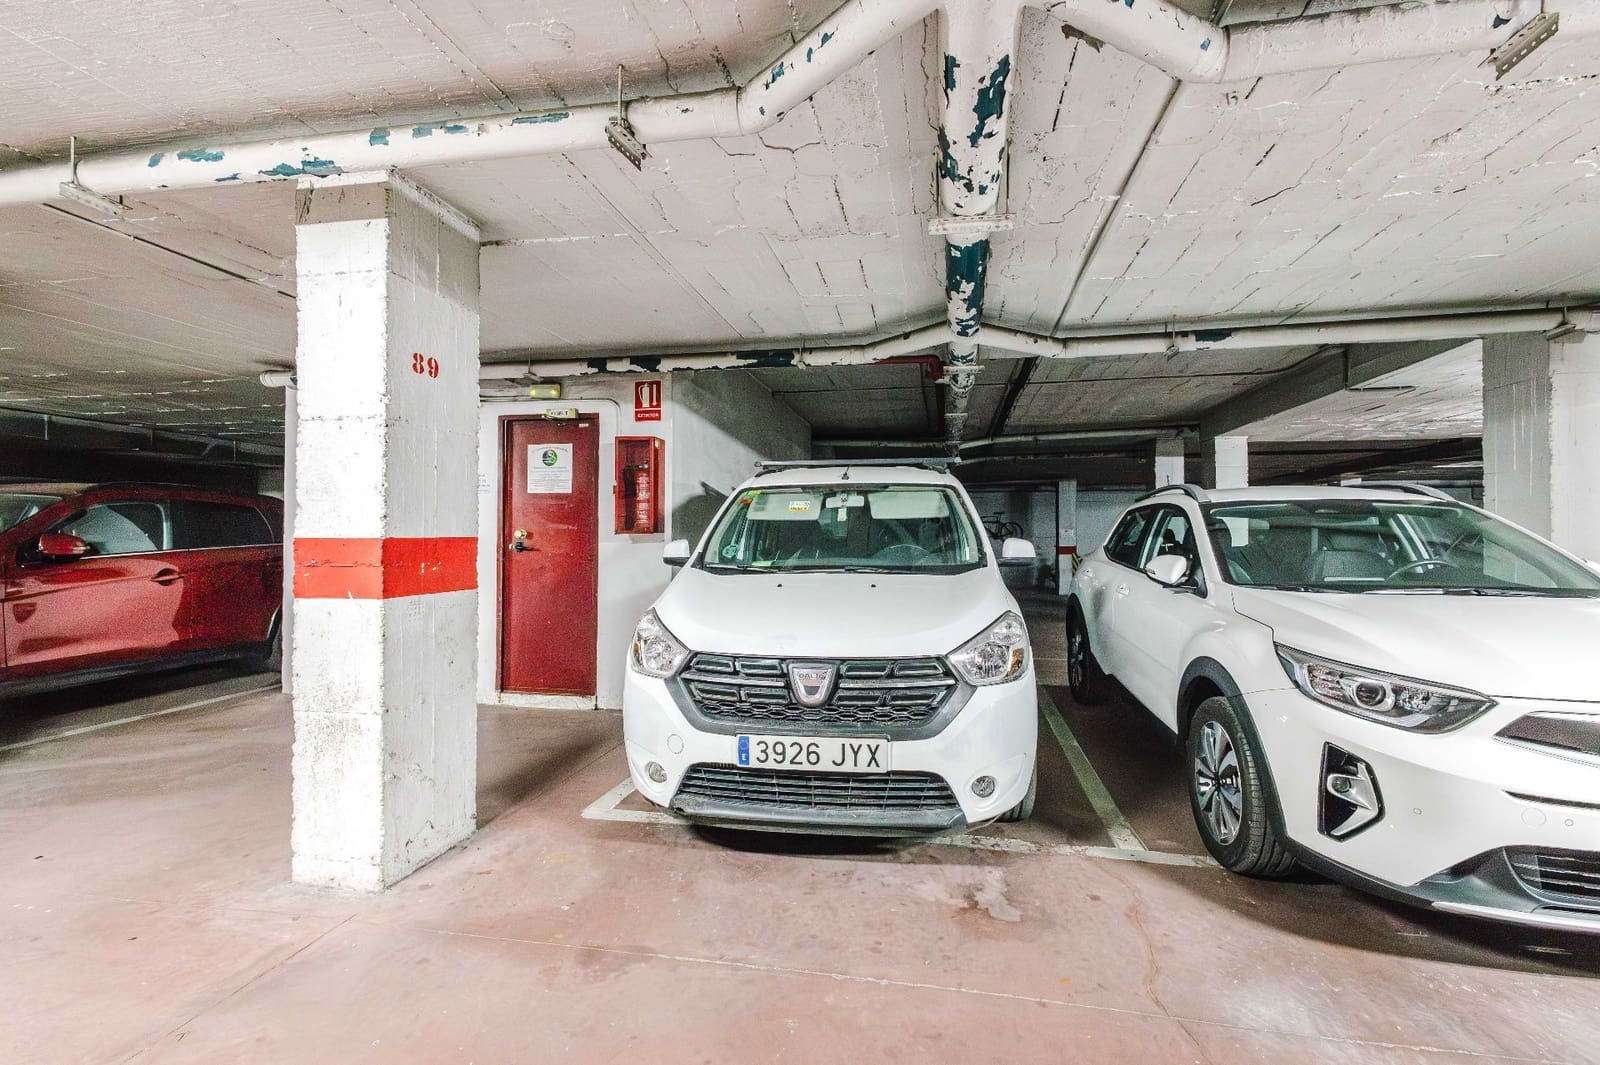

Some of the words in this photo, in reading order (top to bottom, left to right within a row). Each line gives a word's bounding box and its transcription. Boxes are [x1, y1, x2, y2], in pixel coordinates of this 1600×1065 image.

[412, 352, 439, 379] 89
[756, 740, 820, 765] 3926
[832, 743, 880, 768] JYX
